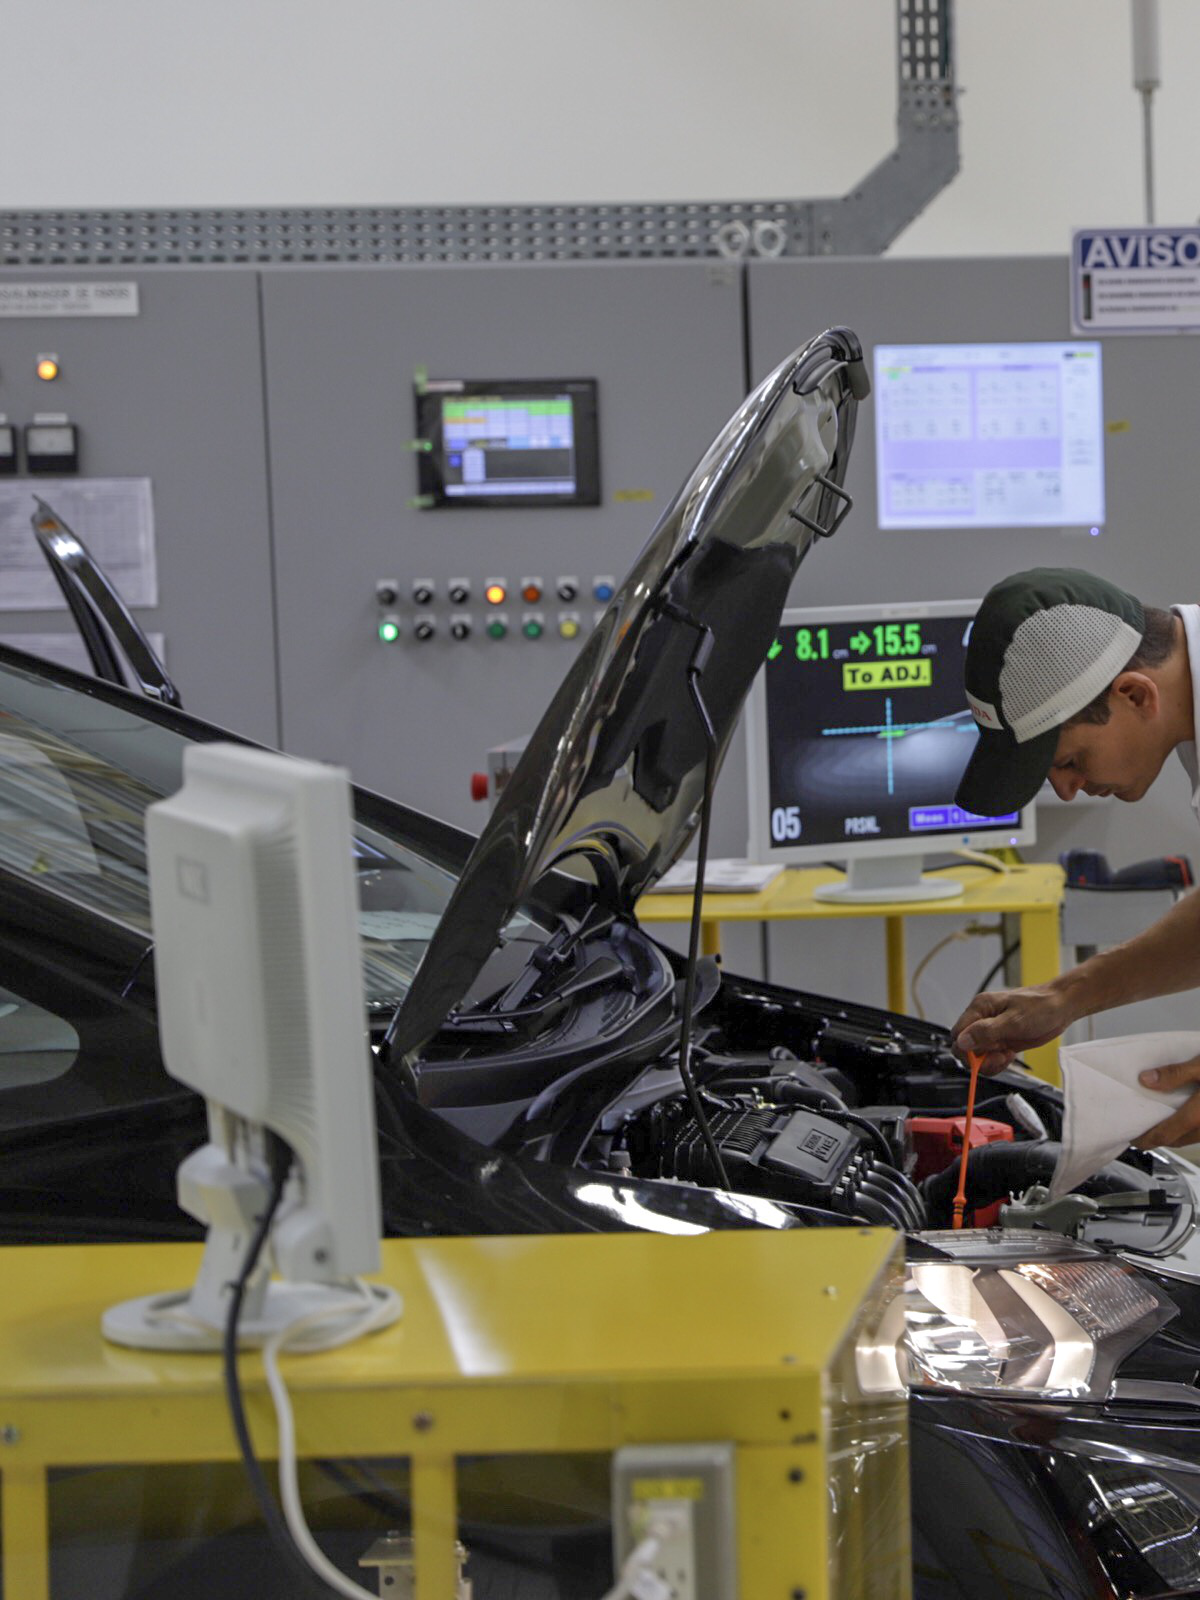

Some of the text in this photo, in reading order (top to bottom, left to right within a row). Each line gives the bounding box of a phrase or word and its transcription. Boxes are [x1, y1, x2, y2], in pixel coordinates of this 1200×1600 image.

[796, 628, 829, 661] 8.1
[873, 623, 922, 656] 15.5
[847, 667, 873, 684] To
[771, 806, 801, 841] 05
